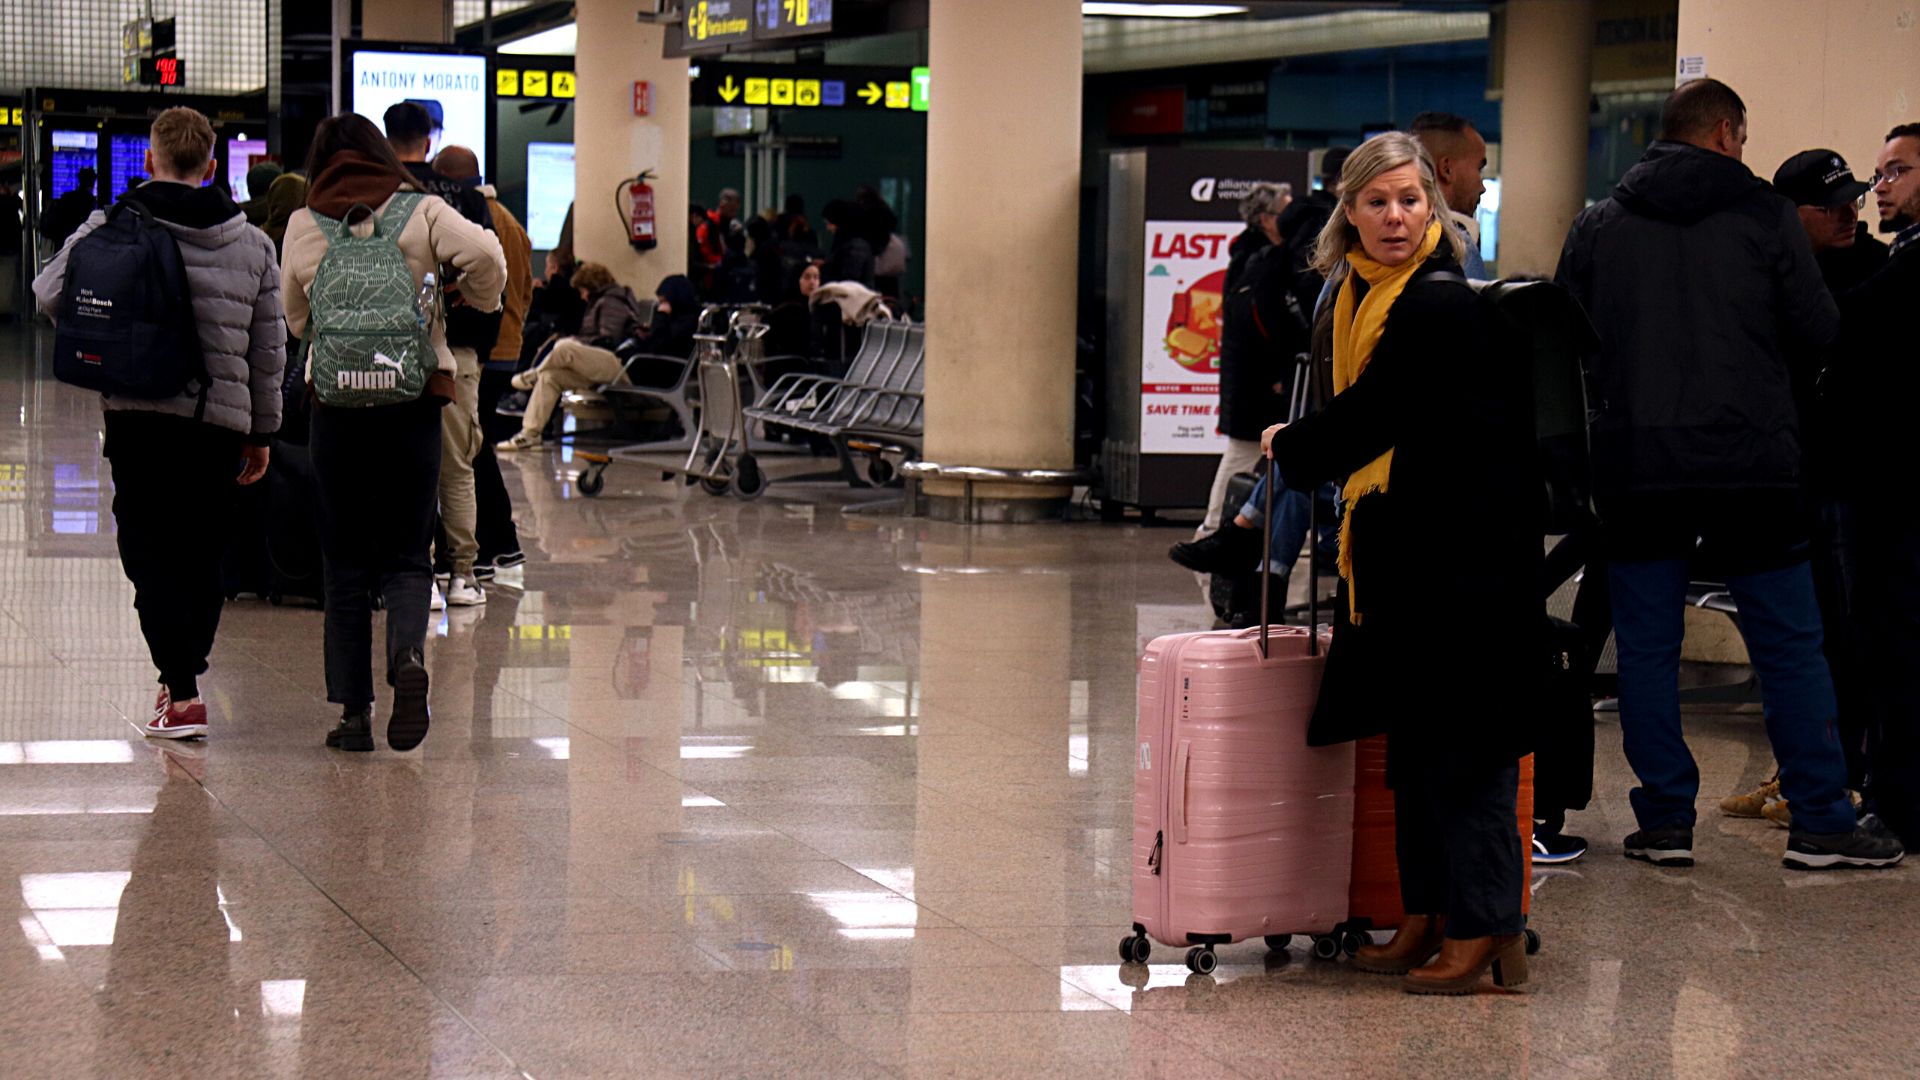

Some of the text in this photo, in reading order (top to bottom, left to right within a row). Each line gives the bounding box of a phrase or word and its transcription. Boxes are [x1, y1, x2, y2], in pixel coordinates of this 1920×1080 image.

[361, 70, 480, 92] ANTONY MORATO
[1152, 233, 1226, 259] LAST
[337, 369, 397, 390] PUMA
[1154, 385, 1181, 393] WATER
[1146, 404, 1179, 416] SAVE
[1181, 404, 1212, 416] TIME
